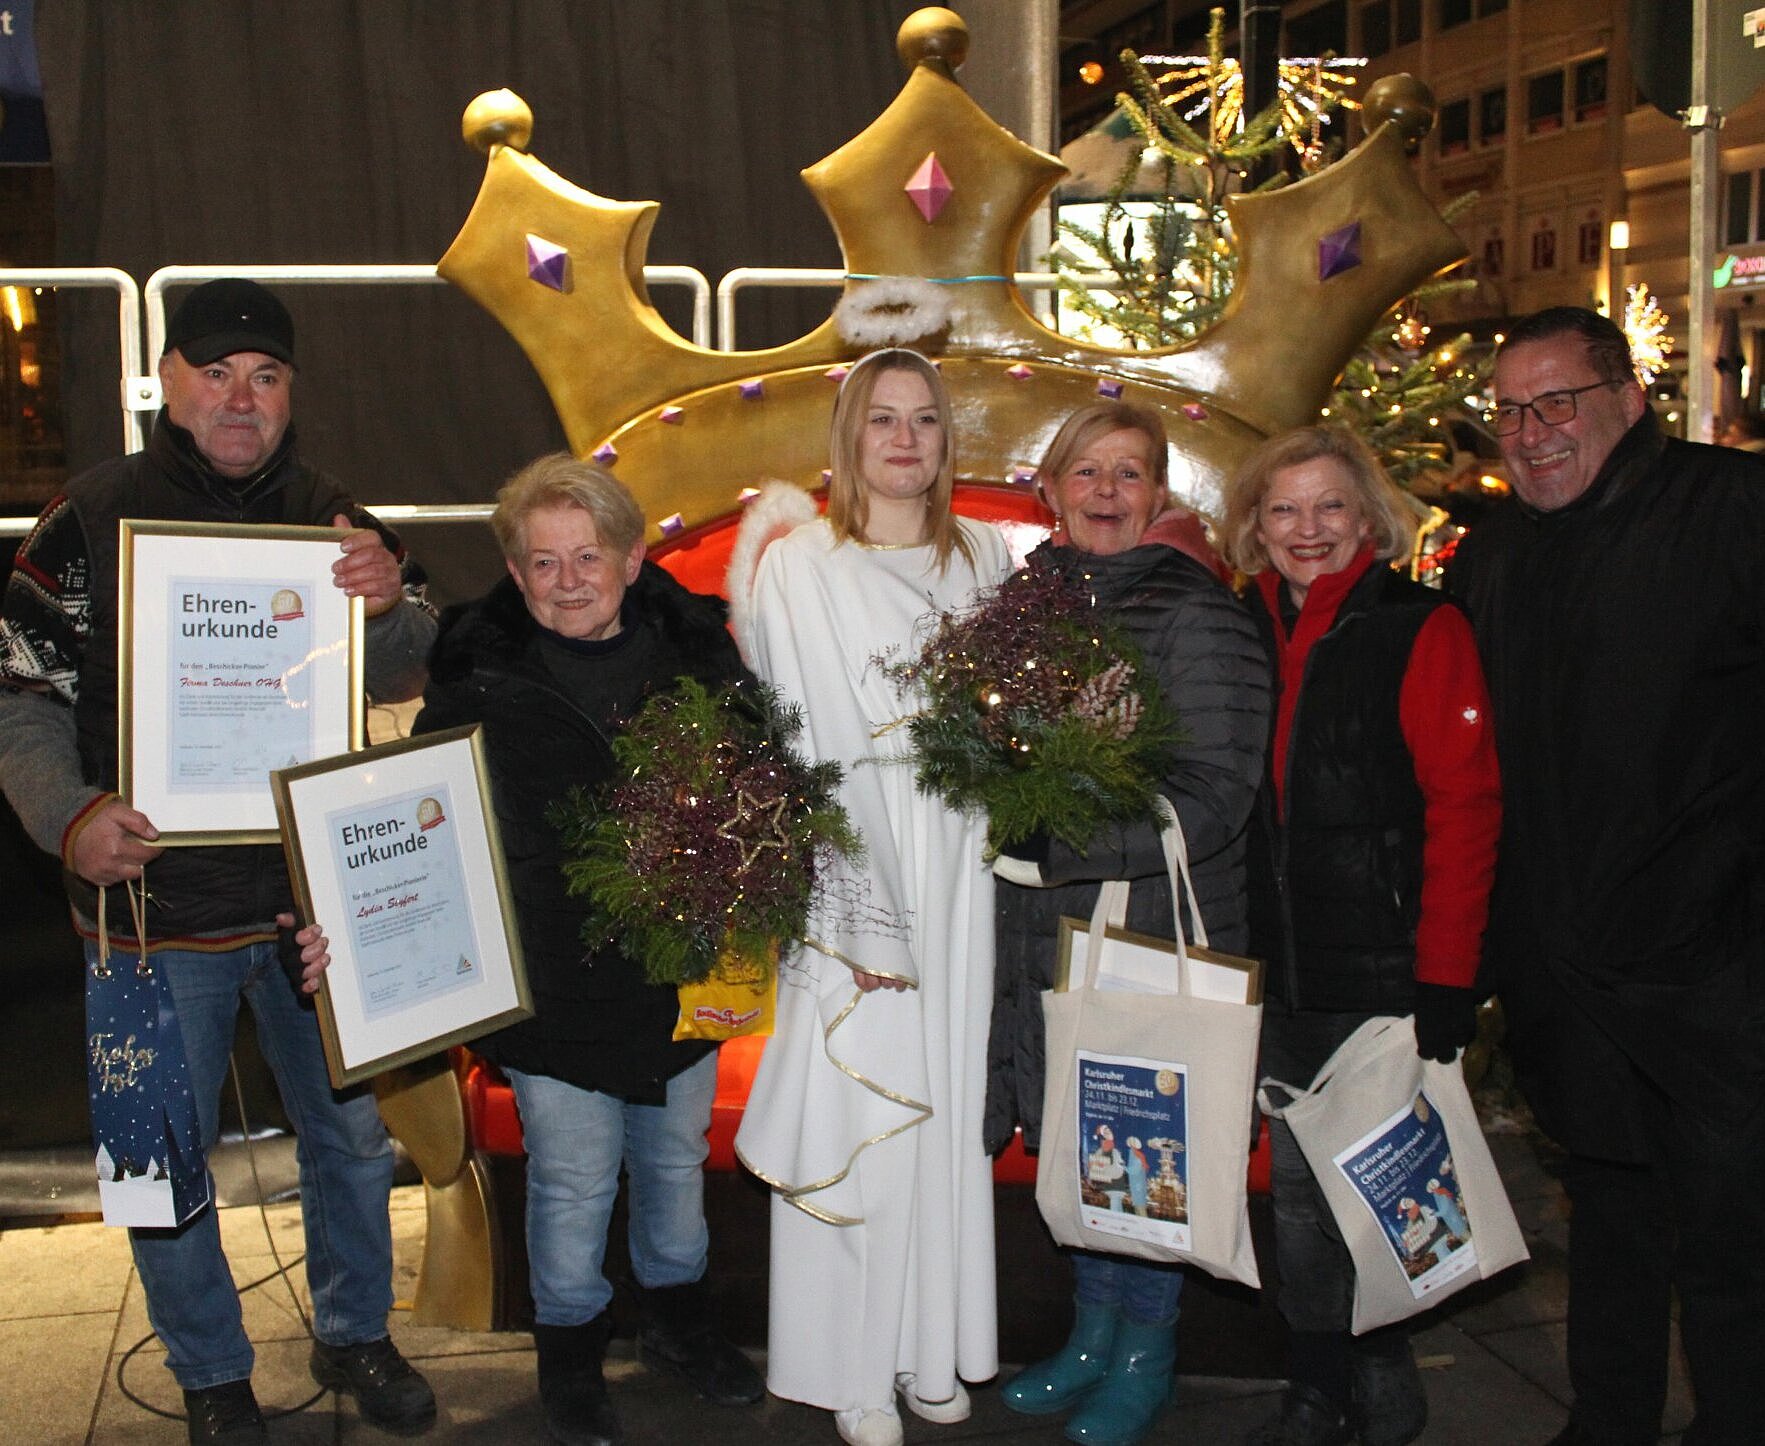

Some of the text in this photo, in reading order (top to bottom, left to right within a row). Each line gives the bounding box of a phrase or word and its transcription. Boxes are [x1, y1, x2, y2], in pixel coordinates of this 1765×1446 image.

[182, 593, 257, 614] Ehren-
[182, 618, 278, 639] urkunde
[255, 677, 281, 689] OHG
[342, 818, 405, 846] Ehren-
[347, 833, 428, 869] urkunde
[356, 905, 383, 919] Lydia
[1084, 1067, 1125, 1081] Karlsruher
[1084, 1080, 1154, 1099] Christkindlesmarkt
[1352, 1142, 1393, 1175] Karlsruher
